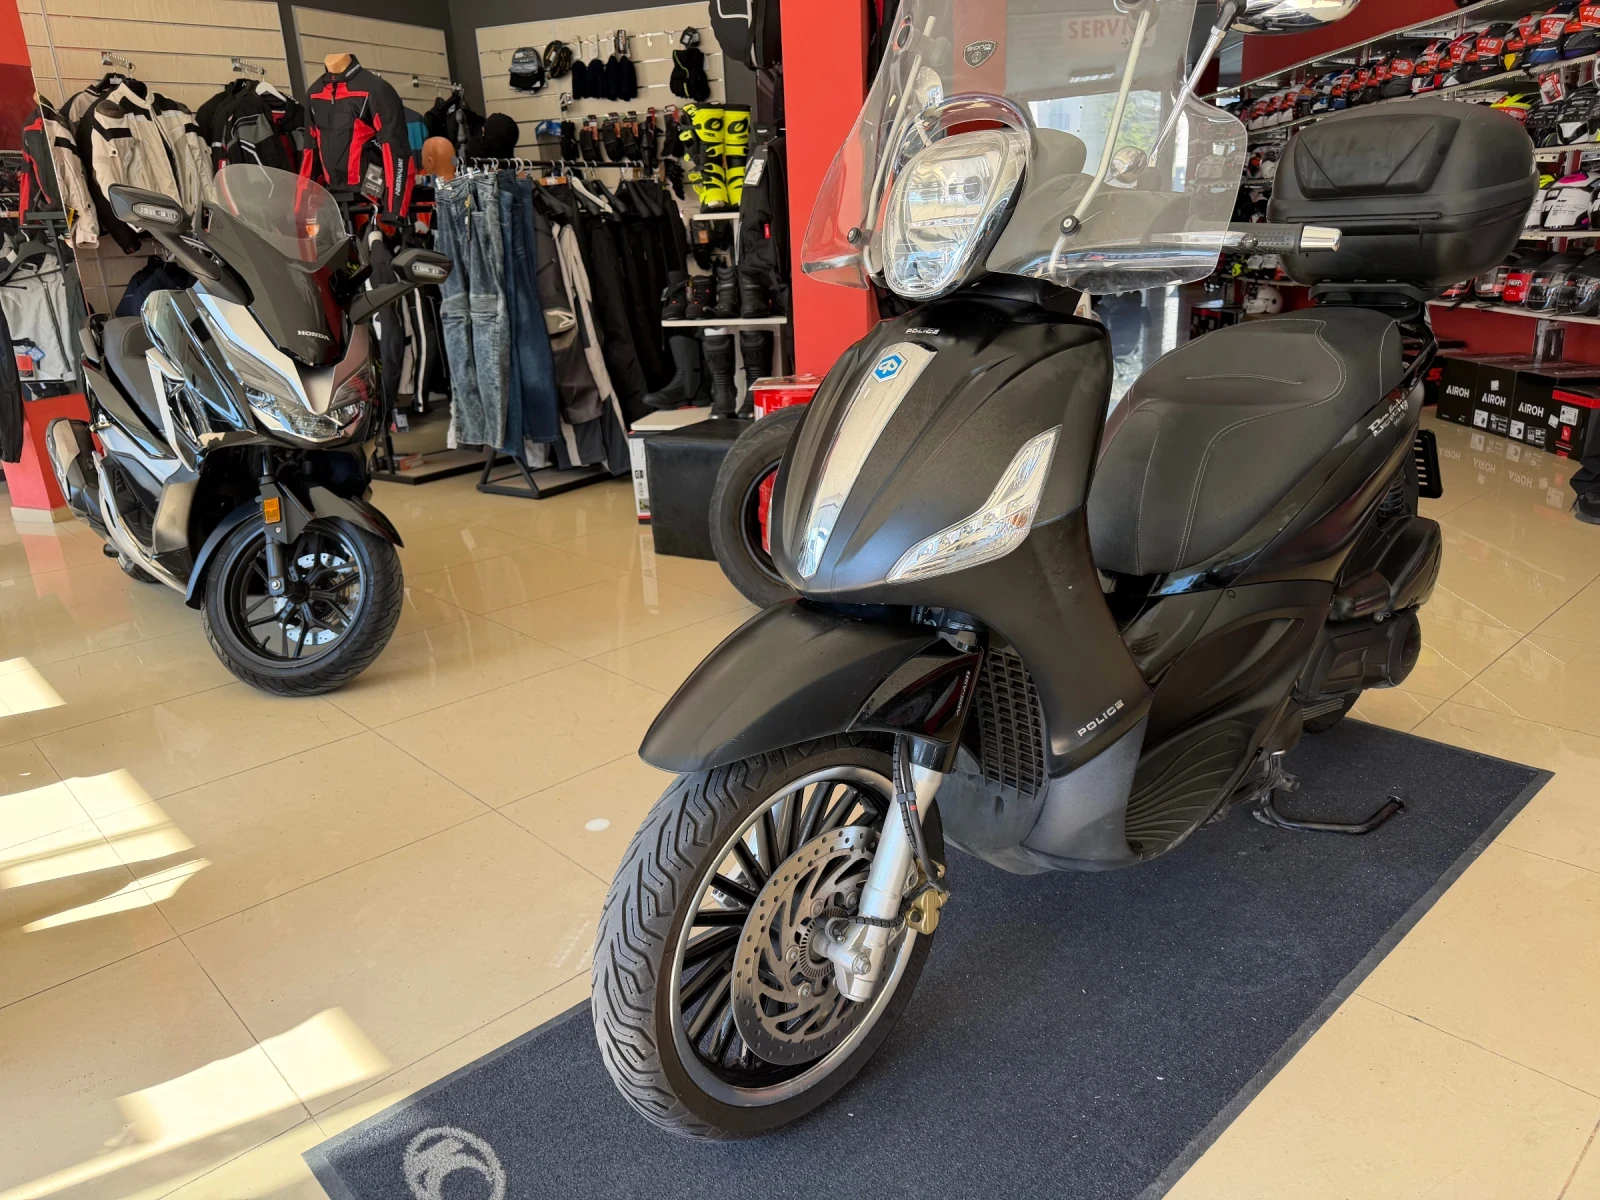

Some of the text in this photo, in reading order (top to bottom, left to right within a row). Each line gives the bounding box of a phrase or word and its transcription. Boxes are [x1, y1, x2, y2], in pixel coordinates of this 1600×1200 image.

[1068, 18, 1128, 39] SERVI
[297, 330, 330, 341] HONDA
[905, 327, 940, 335] POLICE
[1445, 384, 1470, 399] AIROH
[1481, 392, 1507, 407] AIROH
[1517, 402, 1545, 418] AIROH
[1076, 699, 1125, 737] POLICE
